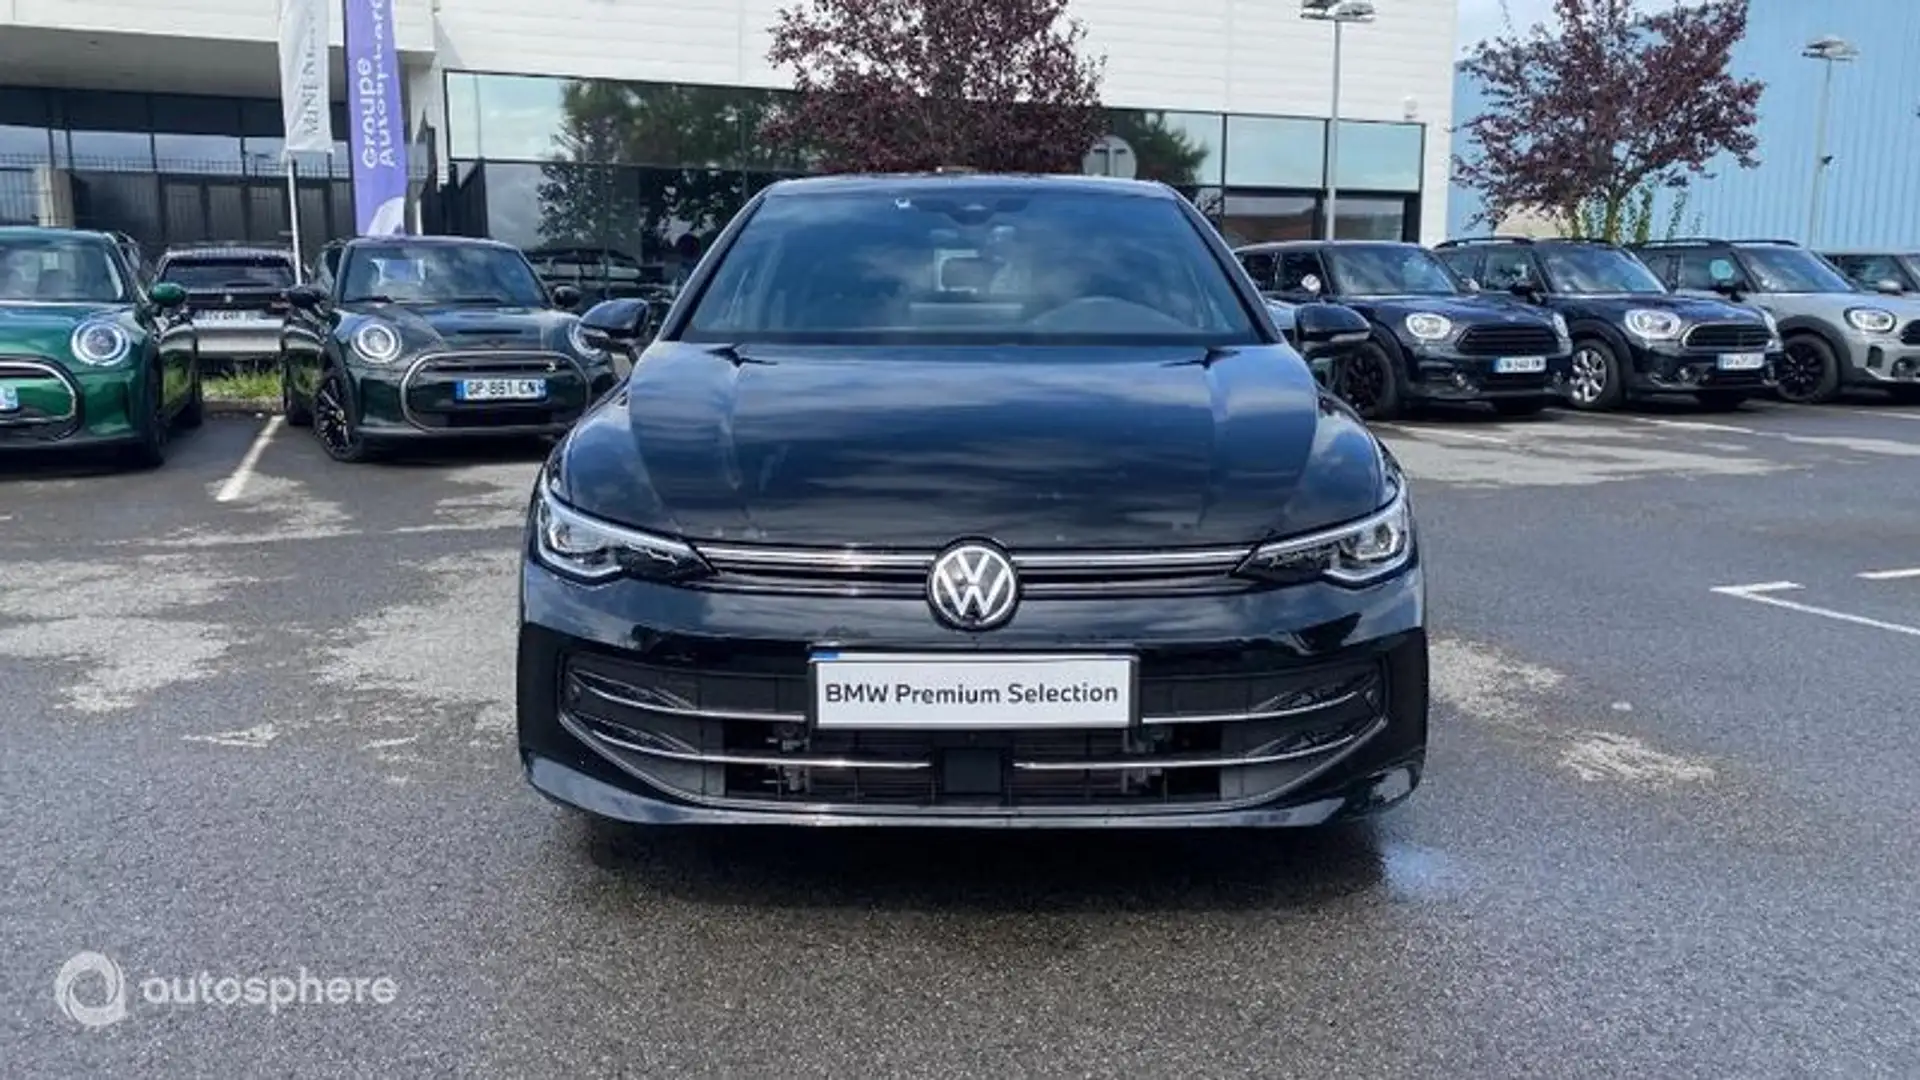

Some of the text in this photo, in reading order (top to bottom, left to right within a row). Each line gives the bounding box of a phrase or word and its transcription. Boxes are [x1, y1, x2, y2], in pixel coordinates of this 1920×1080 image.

[302, 83, 319, 136] MINI
[356, 57, 378, 169] Groupe
[825, 681, 1118, 704] BMW Premium Selection
